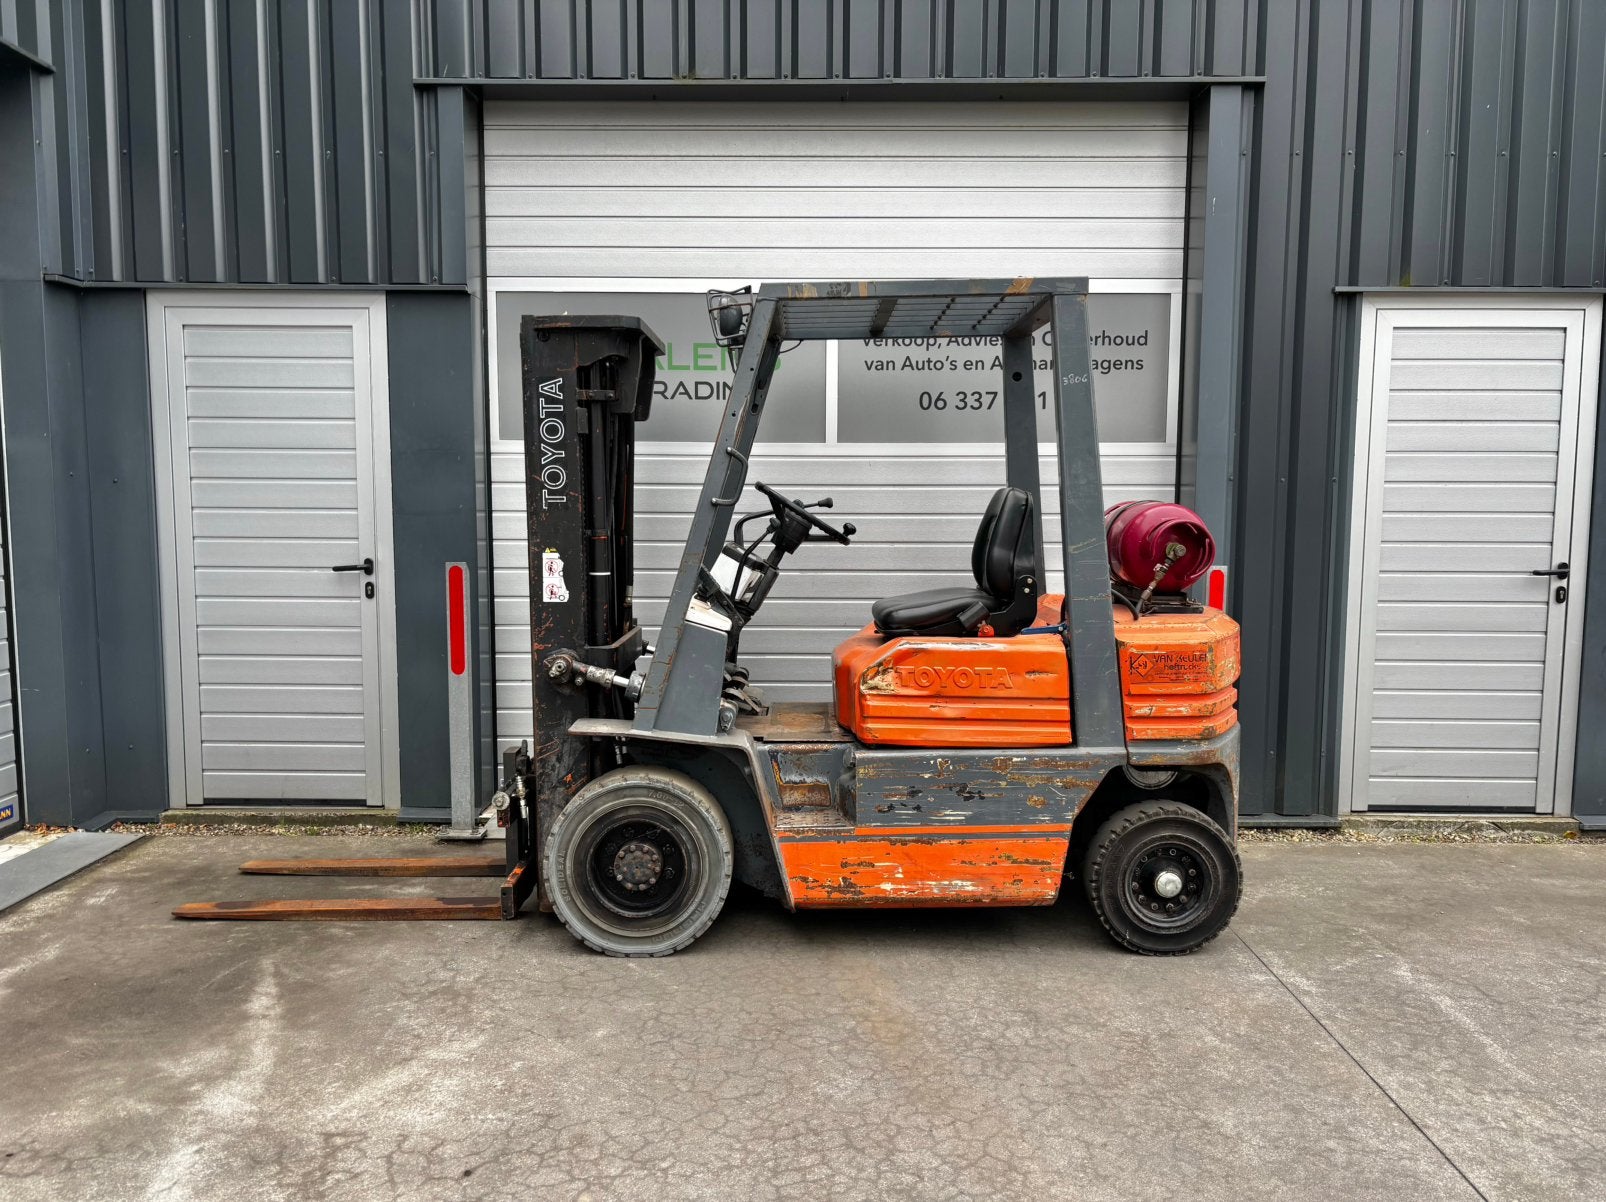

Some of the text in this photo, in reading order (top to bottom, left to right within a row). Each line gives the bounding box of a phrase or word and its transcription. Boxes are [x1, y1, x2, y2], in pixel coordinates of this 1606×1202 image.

[947, 337, 1003, 347] Advie
[864, 360, 896, 371] van
[901, 355, 958, 371] Auto's
[963, 359, 985, 371] en
[919, 391, 947, 410] 06
[955, 391, 998, 410] 337
[539, 377, 567, 509] TOYOTA
[895, 665, 1014, 690] TOYOTA
